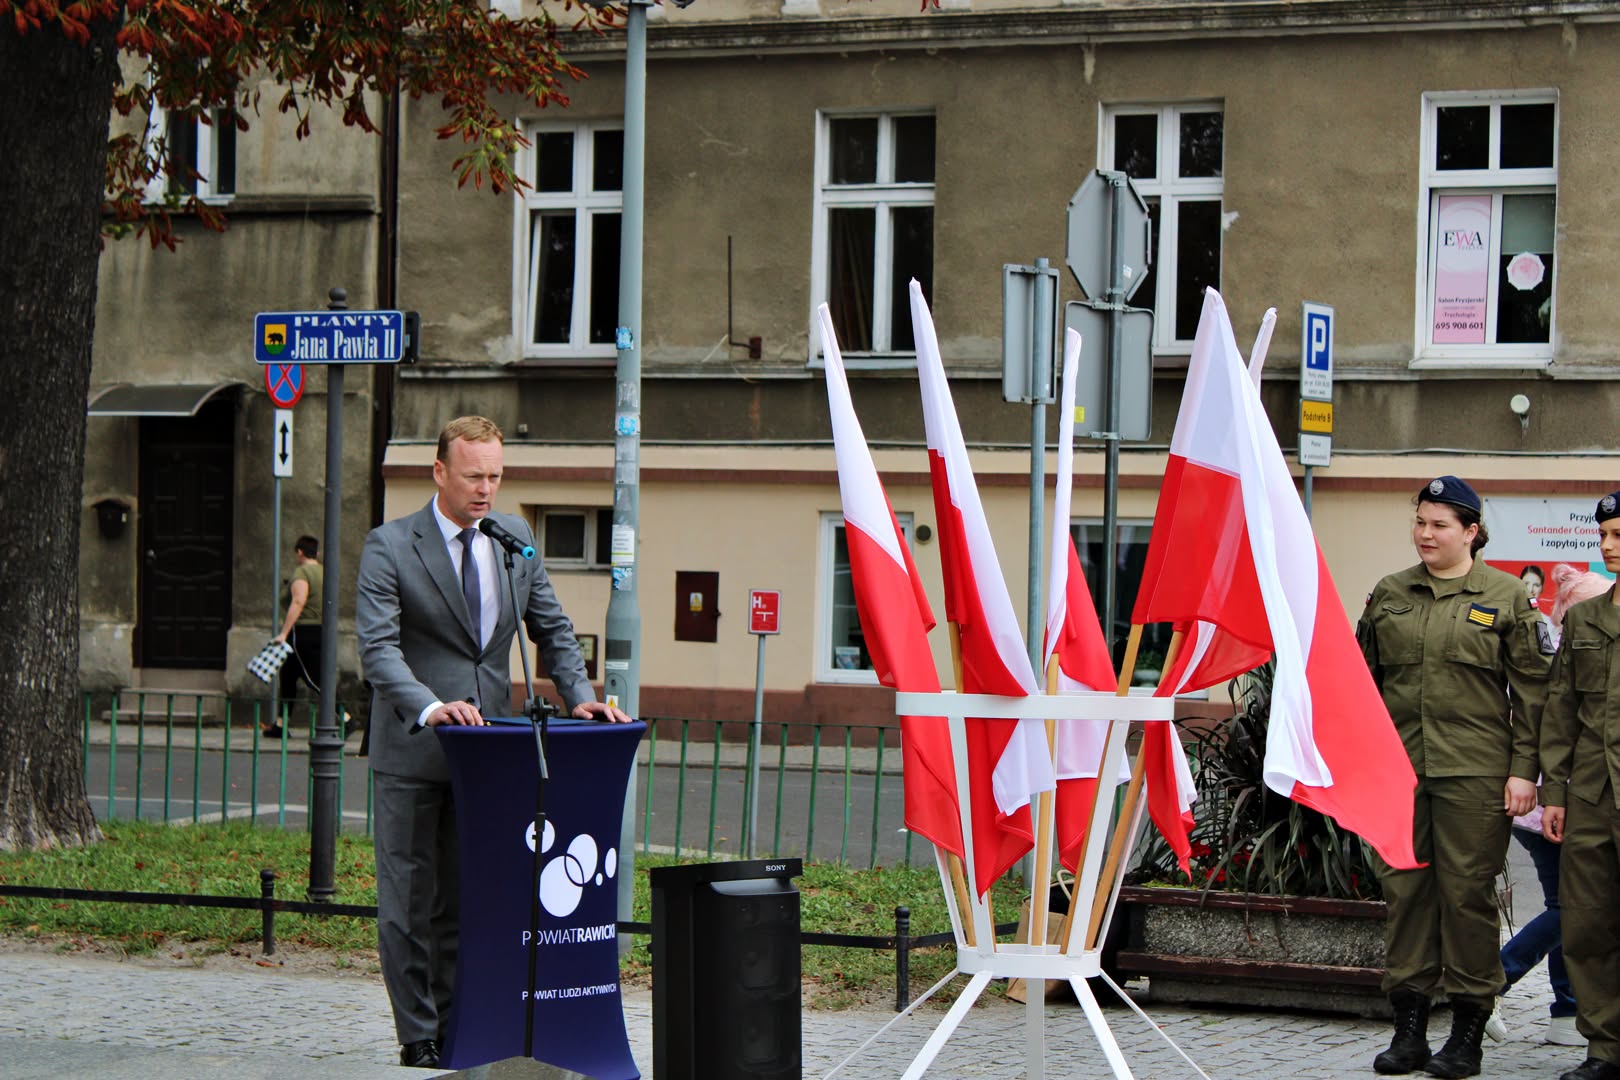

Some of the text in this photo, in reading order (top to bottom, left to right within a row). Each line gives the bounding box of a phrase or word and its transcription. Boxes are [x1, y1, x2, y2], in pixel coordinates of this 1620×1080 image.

[1444, 231, 1482, 247] EWA
[294, 315, 396, 327] PLANTY
[290, 328, 396, 359] Jana Pawła II
[1311, 317, 1327, 365] P
[1303, 410, 1326, 423] Podstrefa
[1527, 525, 1573, 535] Santander
[1541, 538, 1544, 547] i
[1545, 538, 1578, 549] zapytaj
[765, 864, 786, 872] SONY
[521, 983, 617, 1001] PWIAT LUDZI AKTYWNYCH
